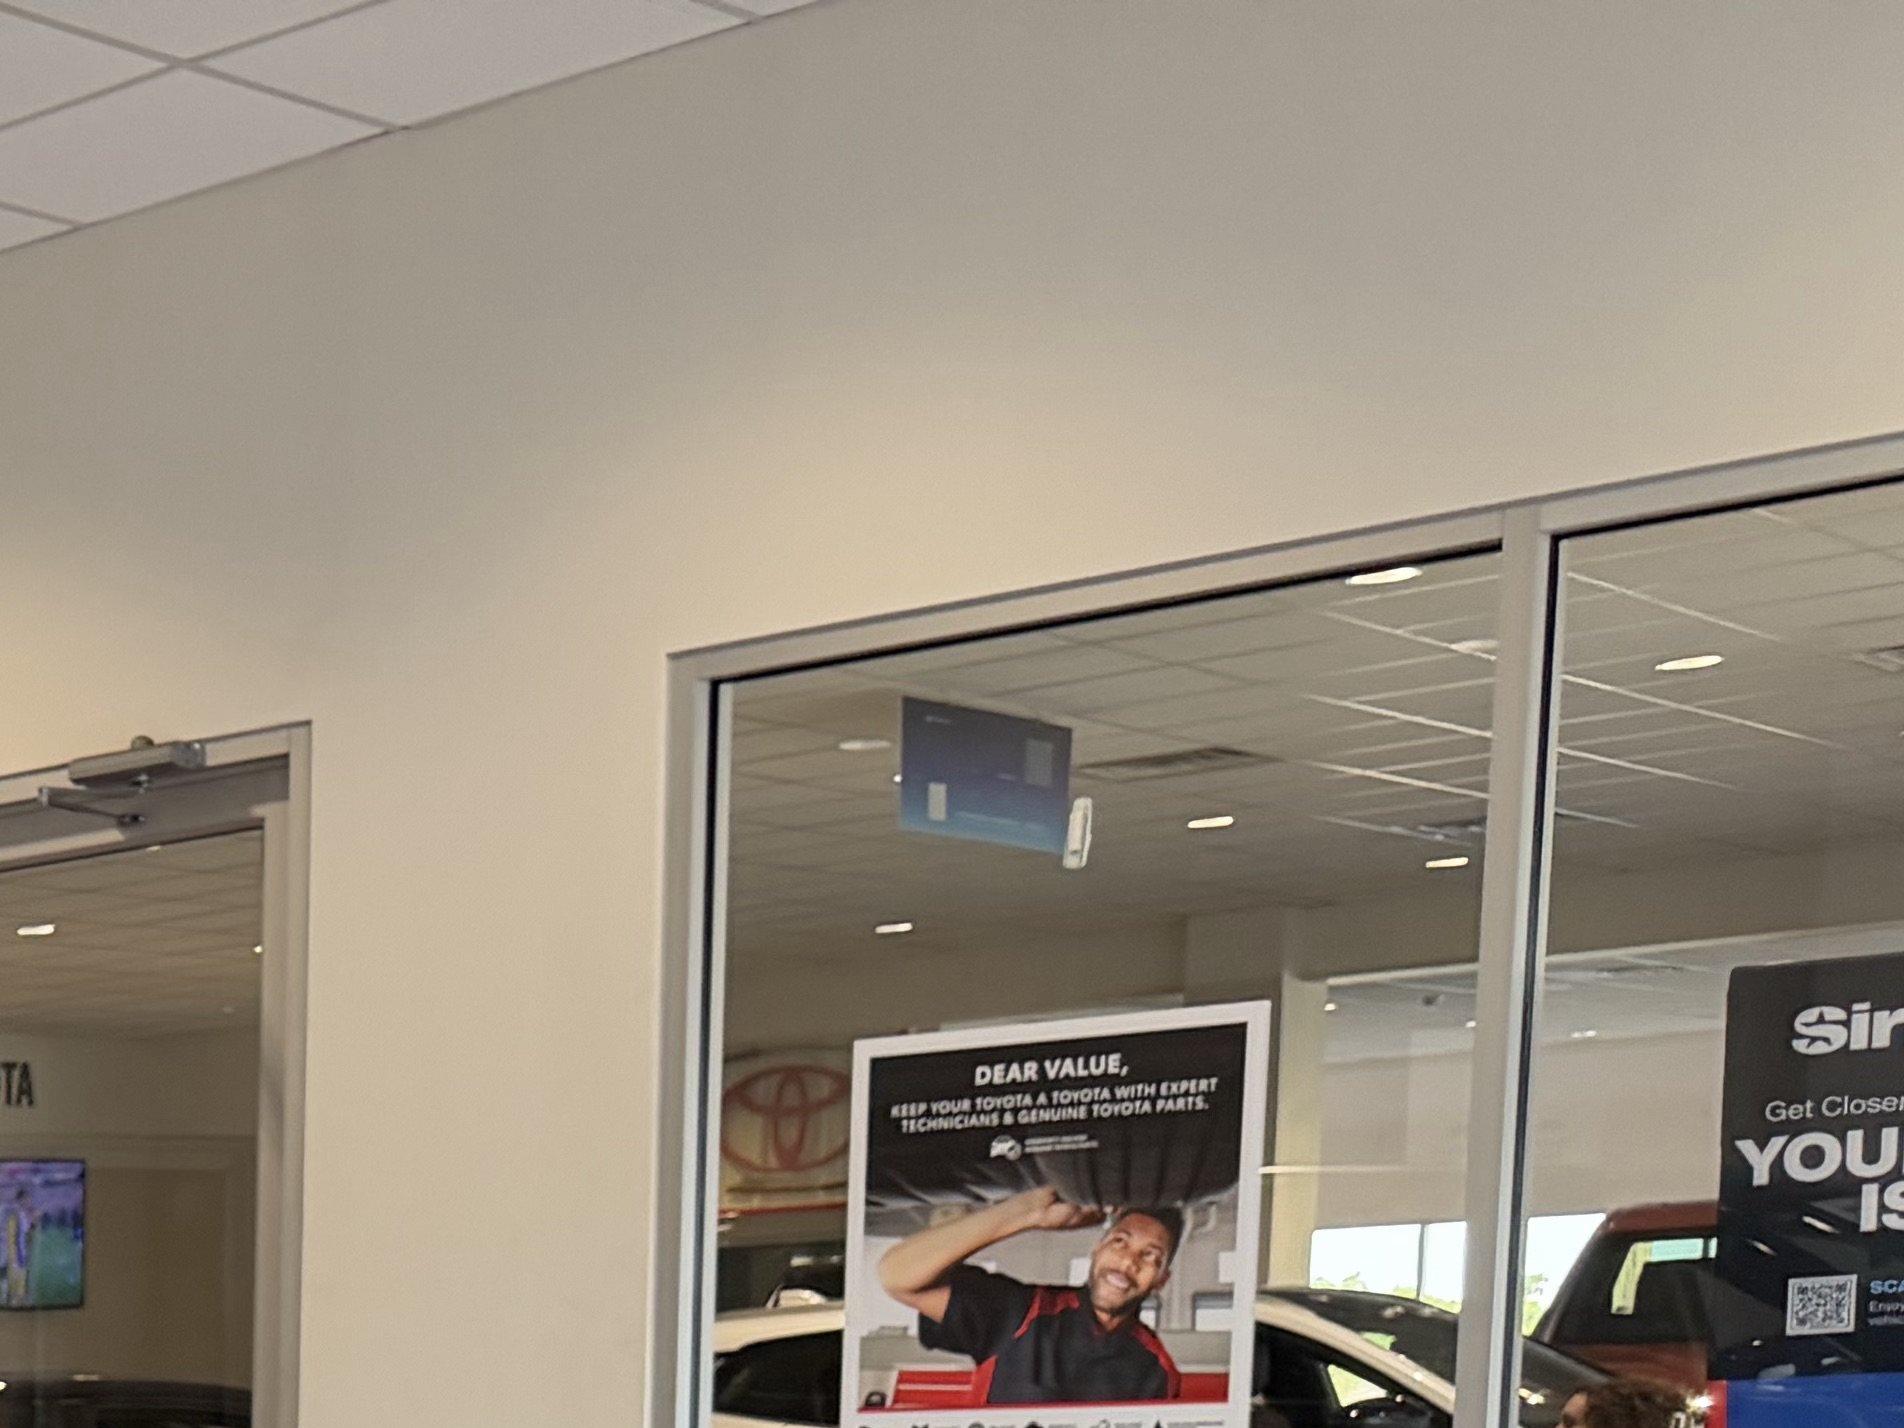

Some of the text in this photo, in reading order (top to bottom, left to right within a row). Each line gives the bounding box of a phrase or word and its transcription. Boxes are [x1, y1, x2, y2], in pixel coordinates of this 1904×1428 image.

[975, 1053, 1130, 1086] DEAR VALUE,
[890, 1076, 1219, 1118] KEEP YOUR TOYOTA A TOYOTA WITH EXPERT
[901, 1110, 1000, 1134] TECHNICIANS
[1017, 1105, 1088, 1125] GENUINE
[1092, 1100, 1154, 1119] TOYOTA
[1156, 1094, 1211, 1114] PARTS.
[1765, 1100, 1815, 1122] Get
[1735, 1127, 1904, 1187] YOU
